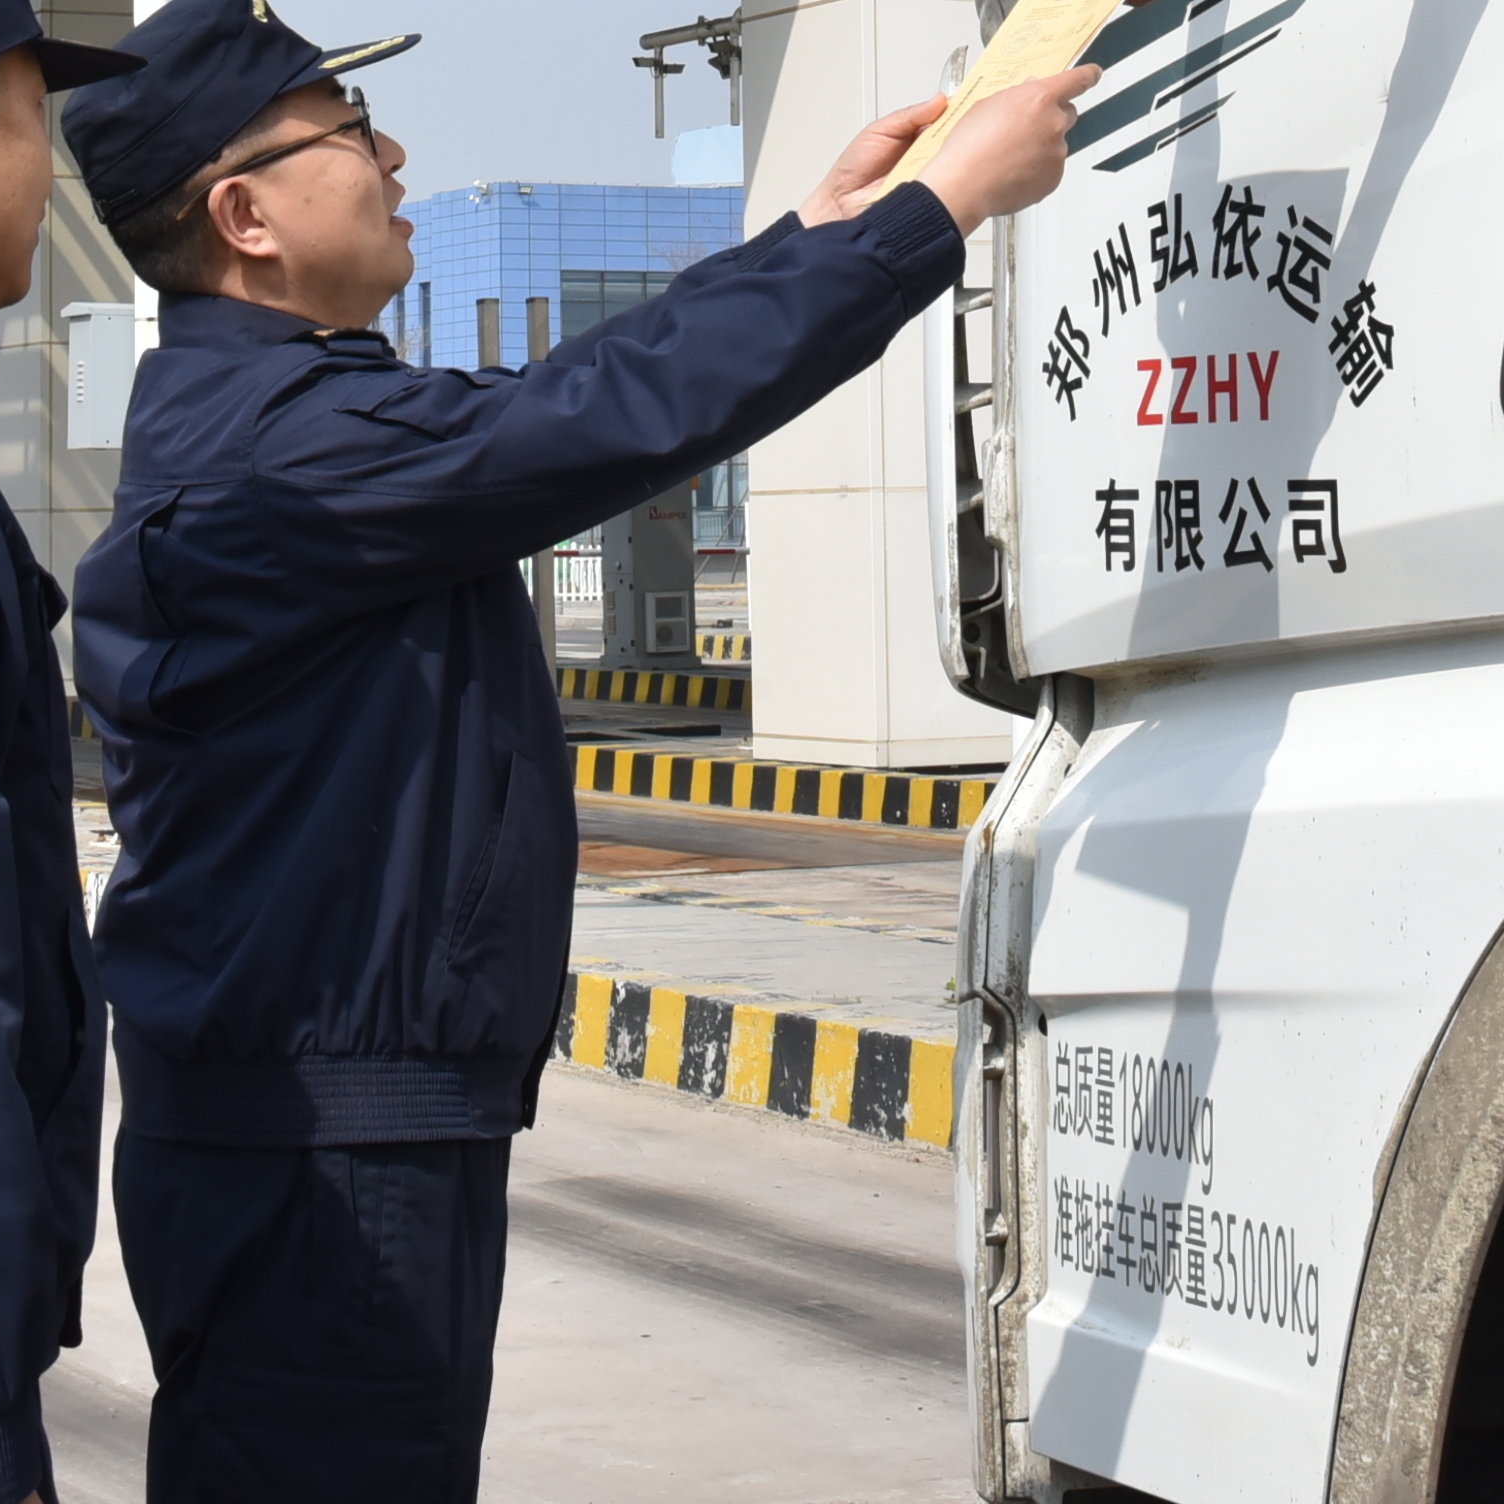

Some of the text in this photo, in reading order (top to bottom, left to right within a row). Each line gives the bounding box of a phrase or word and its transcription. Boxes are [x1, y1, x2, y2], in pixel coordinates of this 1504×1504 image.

[1042, 184, 1395, 420] 郑州弘依运输
[1136, 350, 1280, 426] ZZHY
[1095, 476, 1347, 573] 有限公司
[1052, 1040, 1215, 1196] 总质量18000kg
[1052, 1175, 1320, 1367] 准拖挂车总质量35000kg
